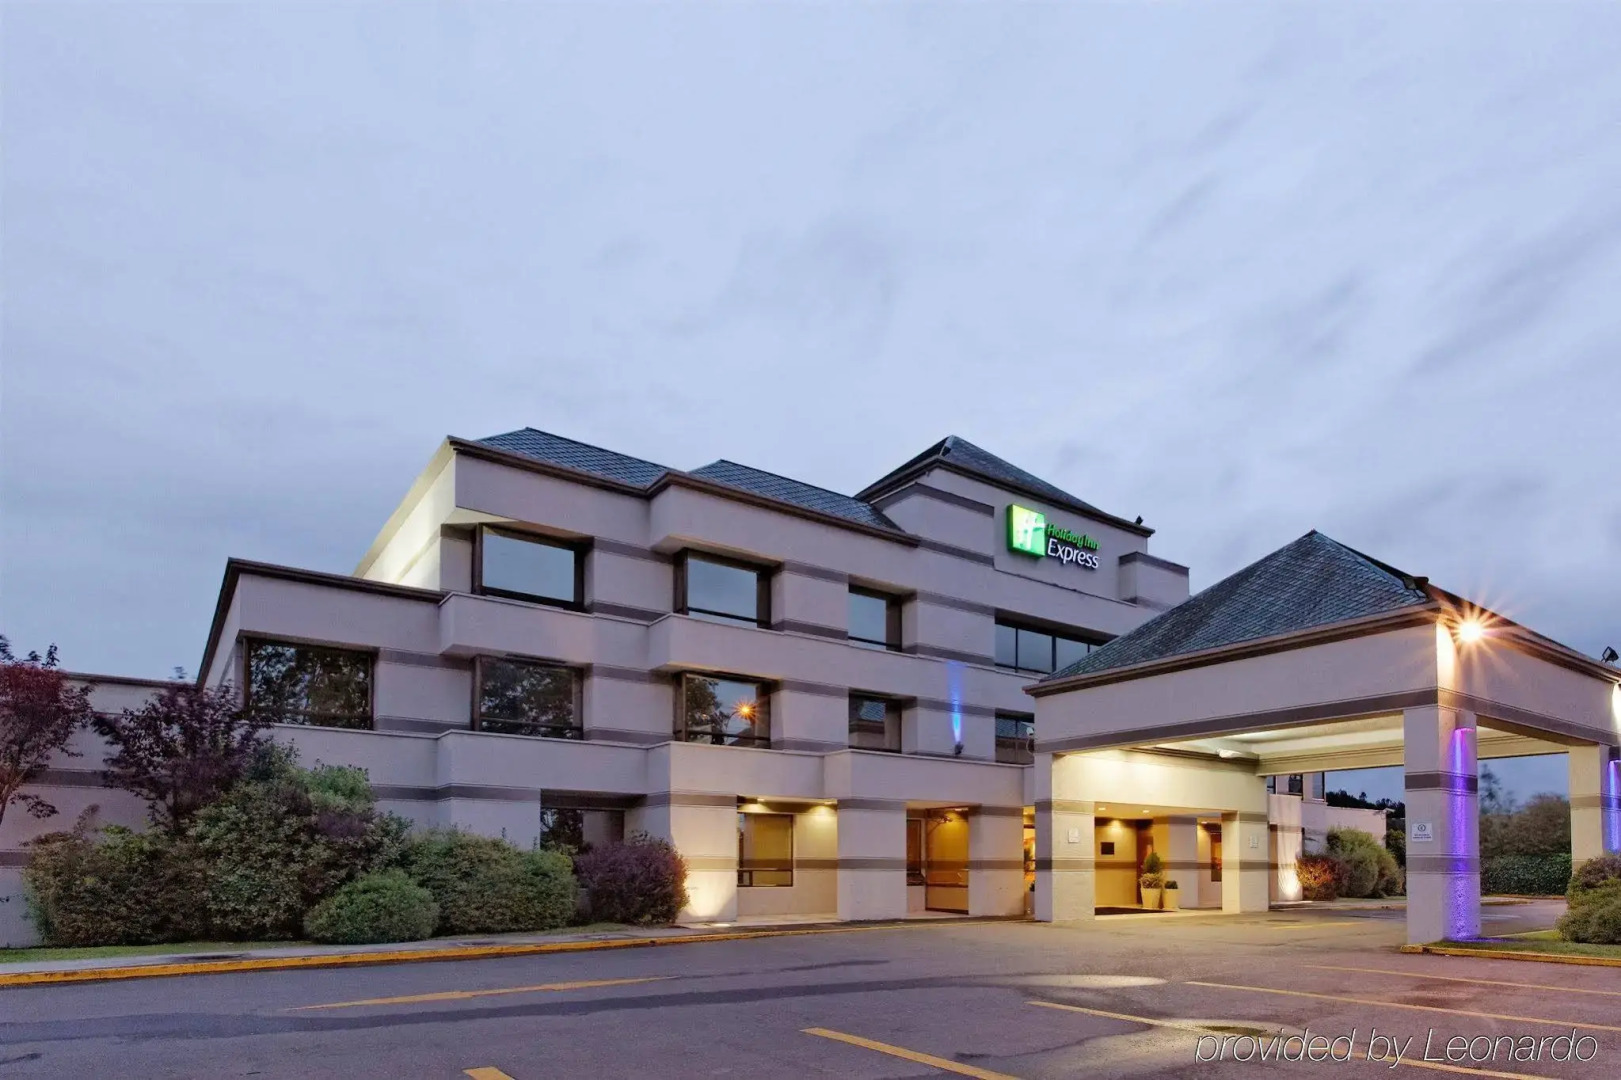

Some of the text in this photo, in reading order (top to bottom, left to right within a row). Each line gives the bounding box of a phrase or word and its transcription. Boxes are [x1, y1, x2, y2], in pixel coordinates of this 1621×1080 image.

[1047, 523, 1100, 550] Holiday Inn
[1047, 538, 1099, 569] Express
